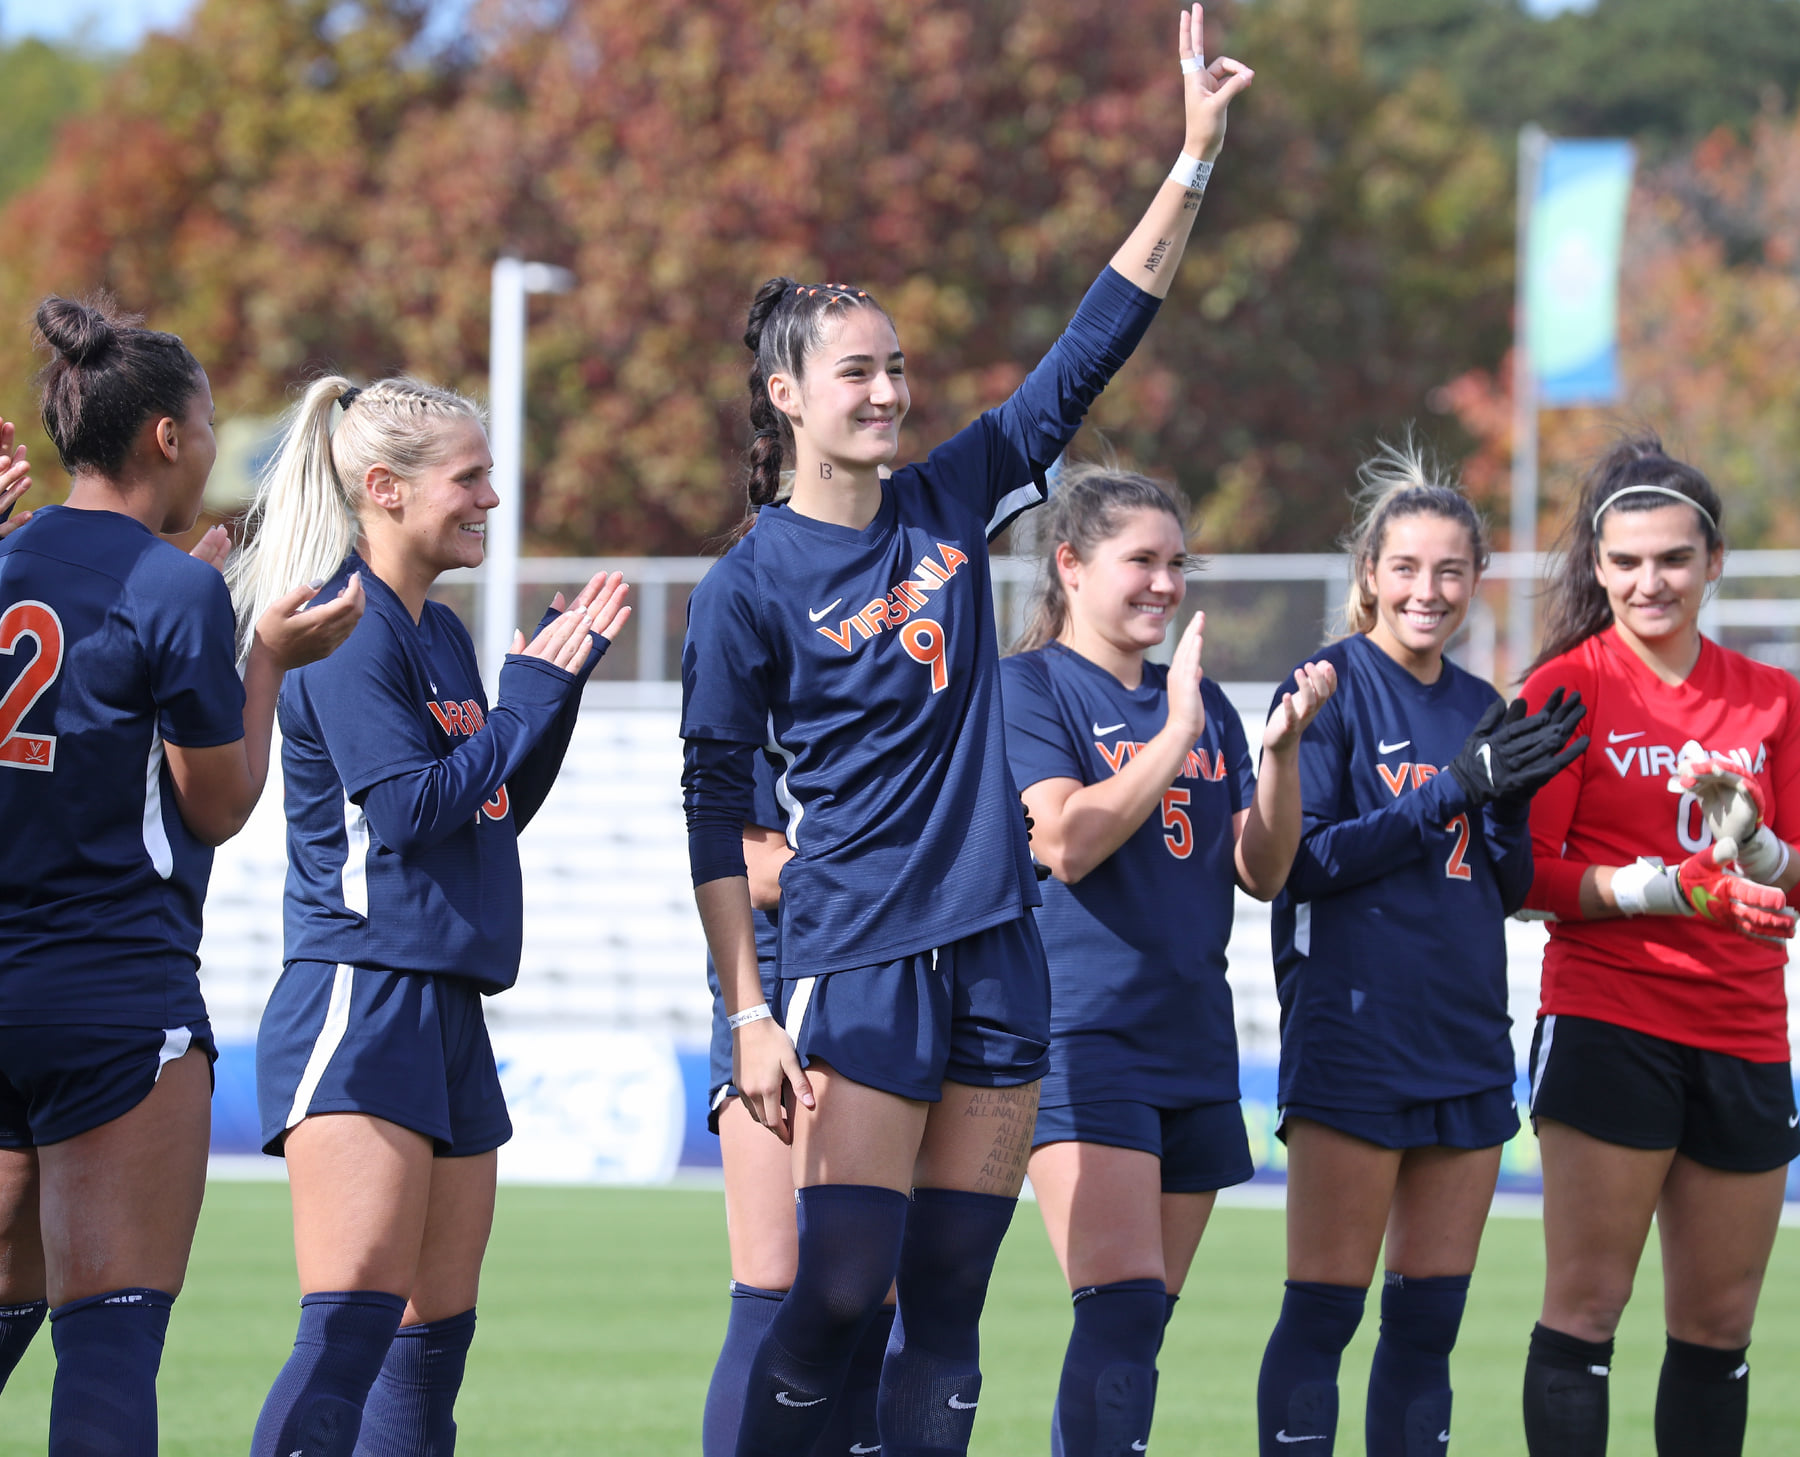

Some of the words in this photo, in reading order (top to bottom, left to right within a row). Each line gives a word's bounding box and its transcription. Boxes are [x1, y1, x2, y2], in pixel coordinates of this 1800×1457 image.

[1144, 238, 1171, 273] ABIDE
[820, 462, 832, 480] 13
[816, 542, 969, 652] VIRGINIA
[0, 599, 65, 772] 2
[899, 618, 949, 694] 9
[1161, 787, 1194, 860] 5
[1445, 812, 1471, 881] 2
